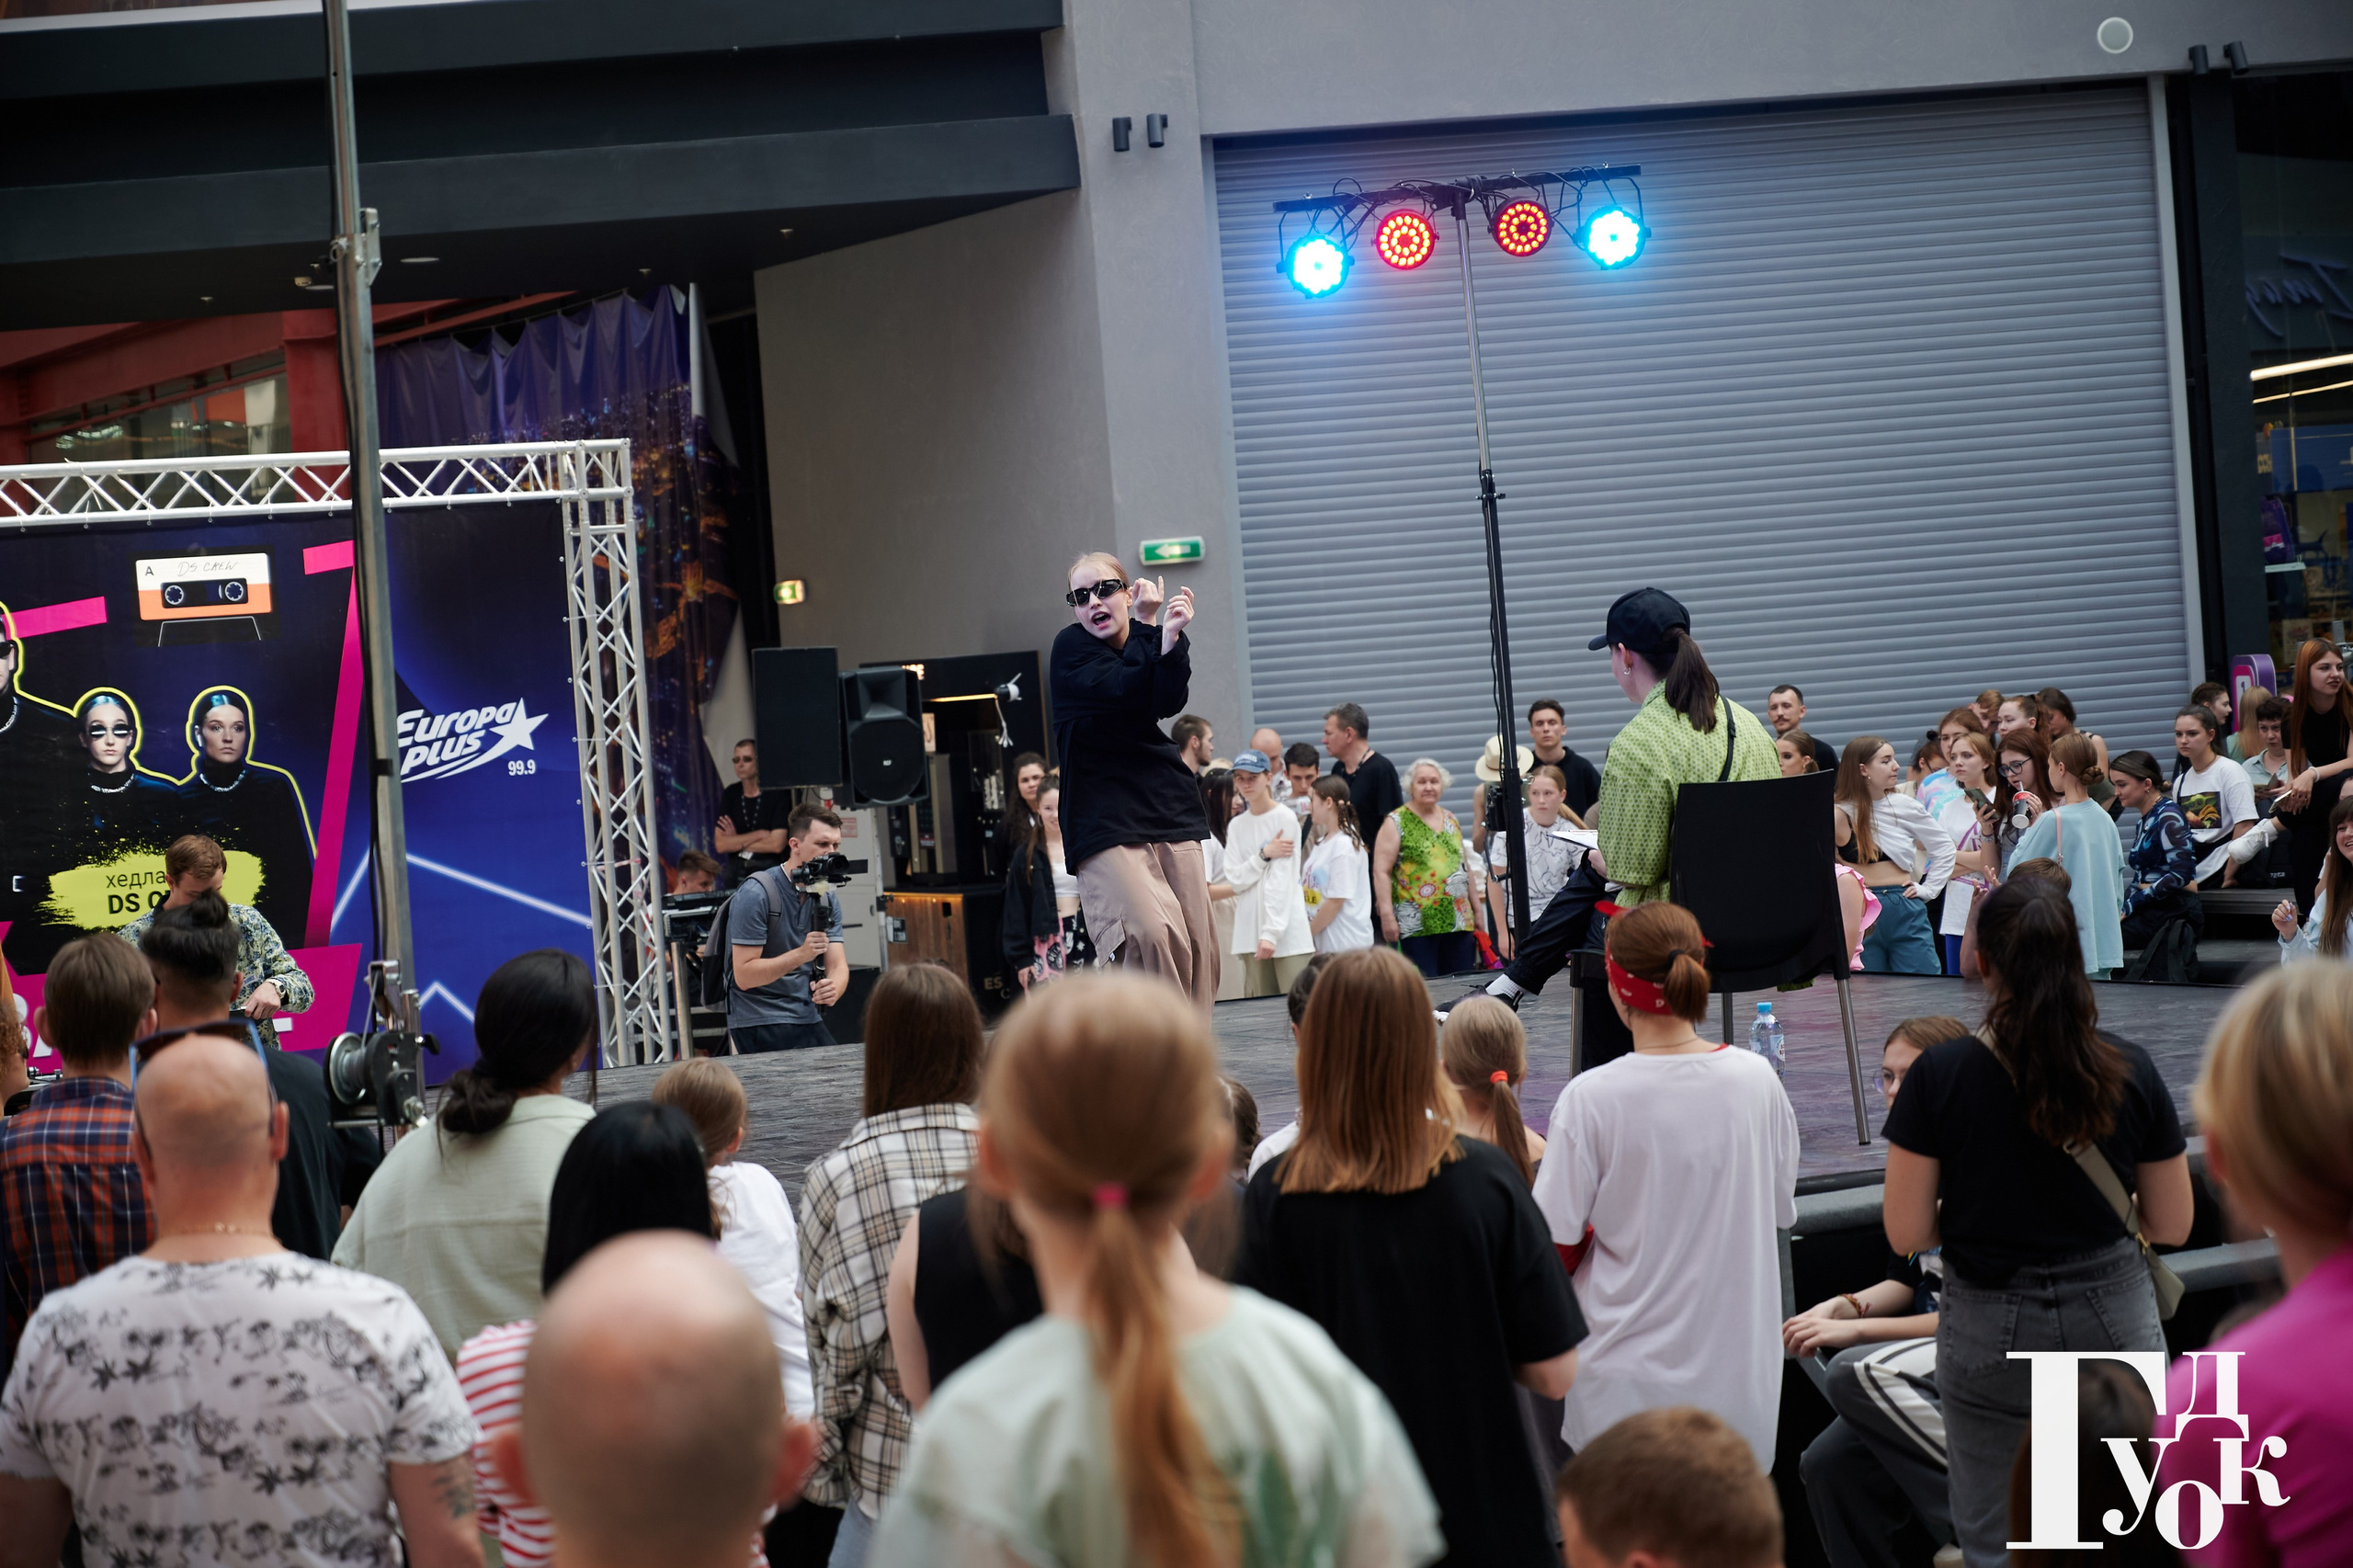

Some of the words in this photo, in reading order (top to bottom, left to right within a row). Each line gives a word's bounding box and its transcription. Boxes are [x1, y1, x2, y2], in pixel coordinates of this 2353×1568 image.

[145, 566, 154, 577] A
[177, 562, 198, 577] DS
[507, 759, 536, 776] 99.9
[106, 870, 166, 890] хедла
[108, 892, 141, 915] DS
